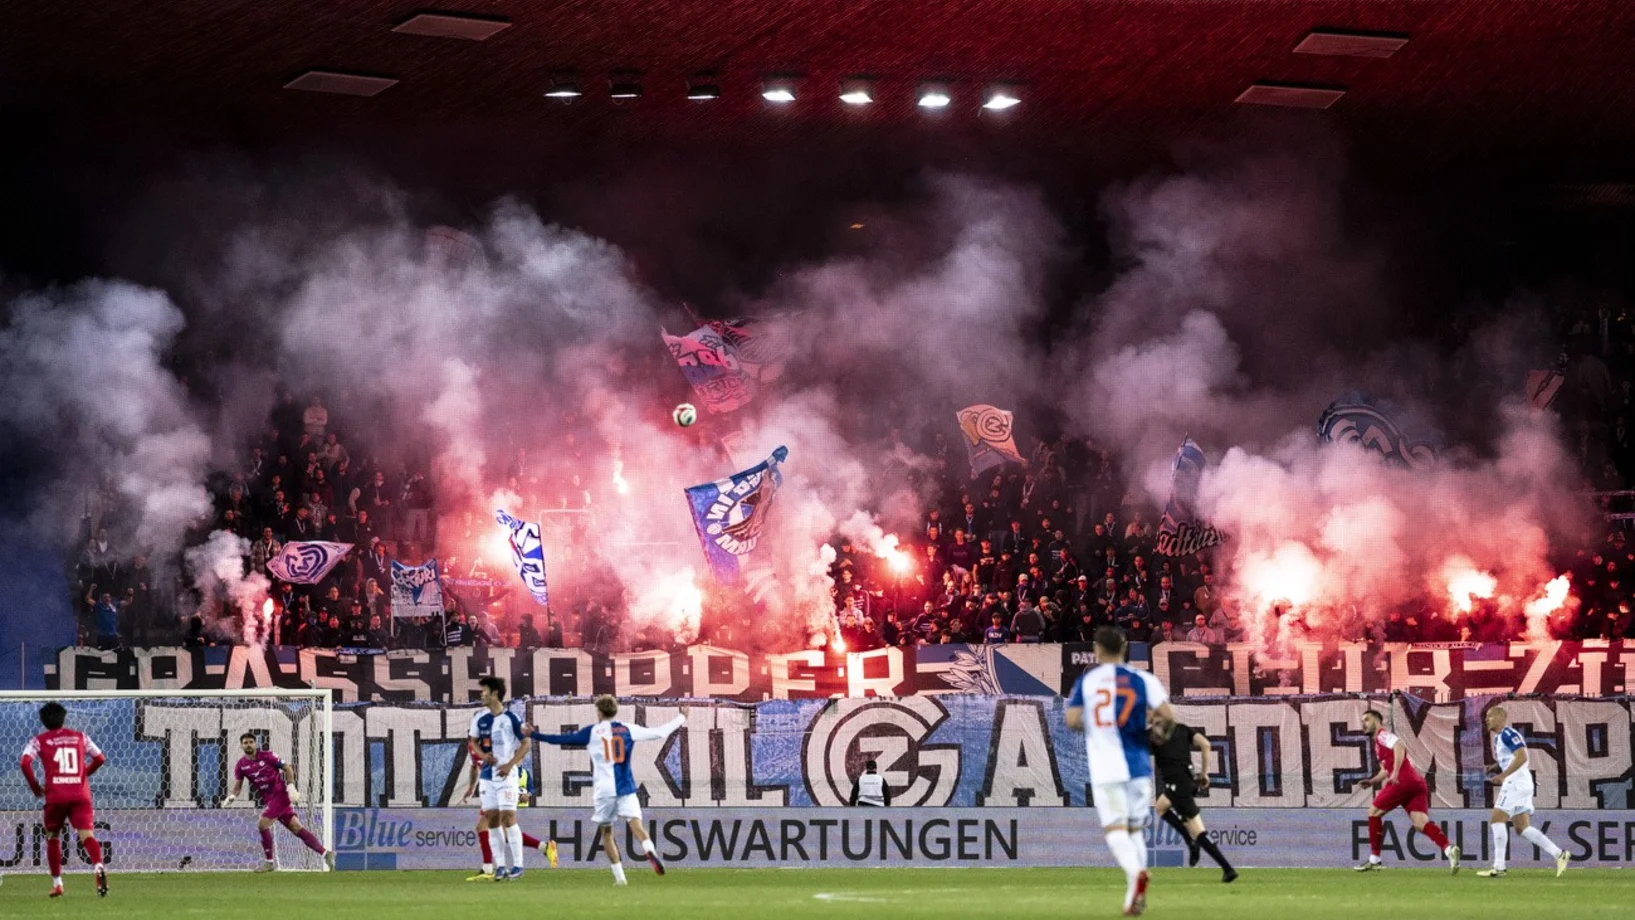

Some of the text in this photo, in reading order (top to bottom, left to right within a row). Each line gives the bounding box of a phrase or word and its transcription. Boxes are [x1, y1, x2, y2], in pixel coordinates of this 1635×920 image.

[1094, 687, 1136, 728] 27
[53, 746, 79, 774] 10
[601, 736, 626, 763] 10
[338, 806, 476, 847] Blue service
[549, 819, 1018, 861] HAUSWARTUNGEN
[1206, 824, 1258, 846] ervice
